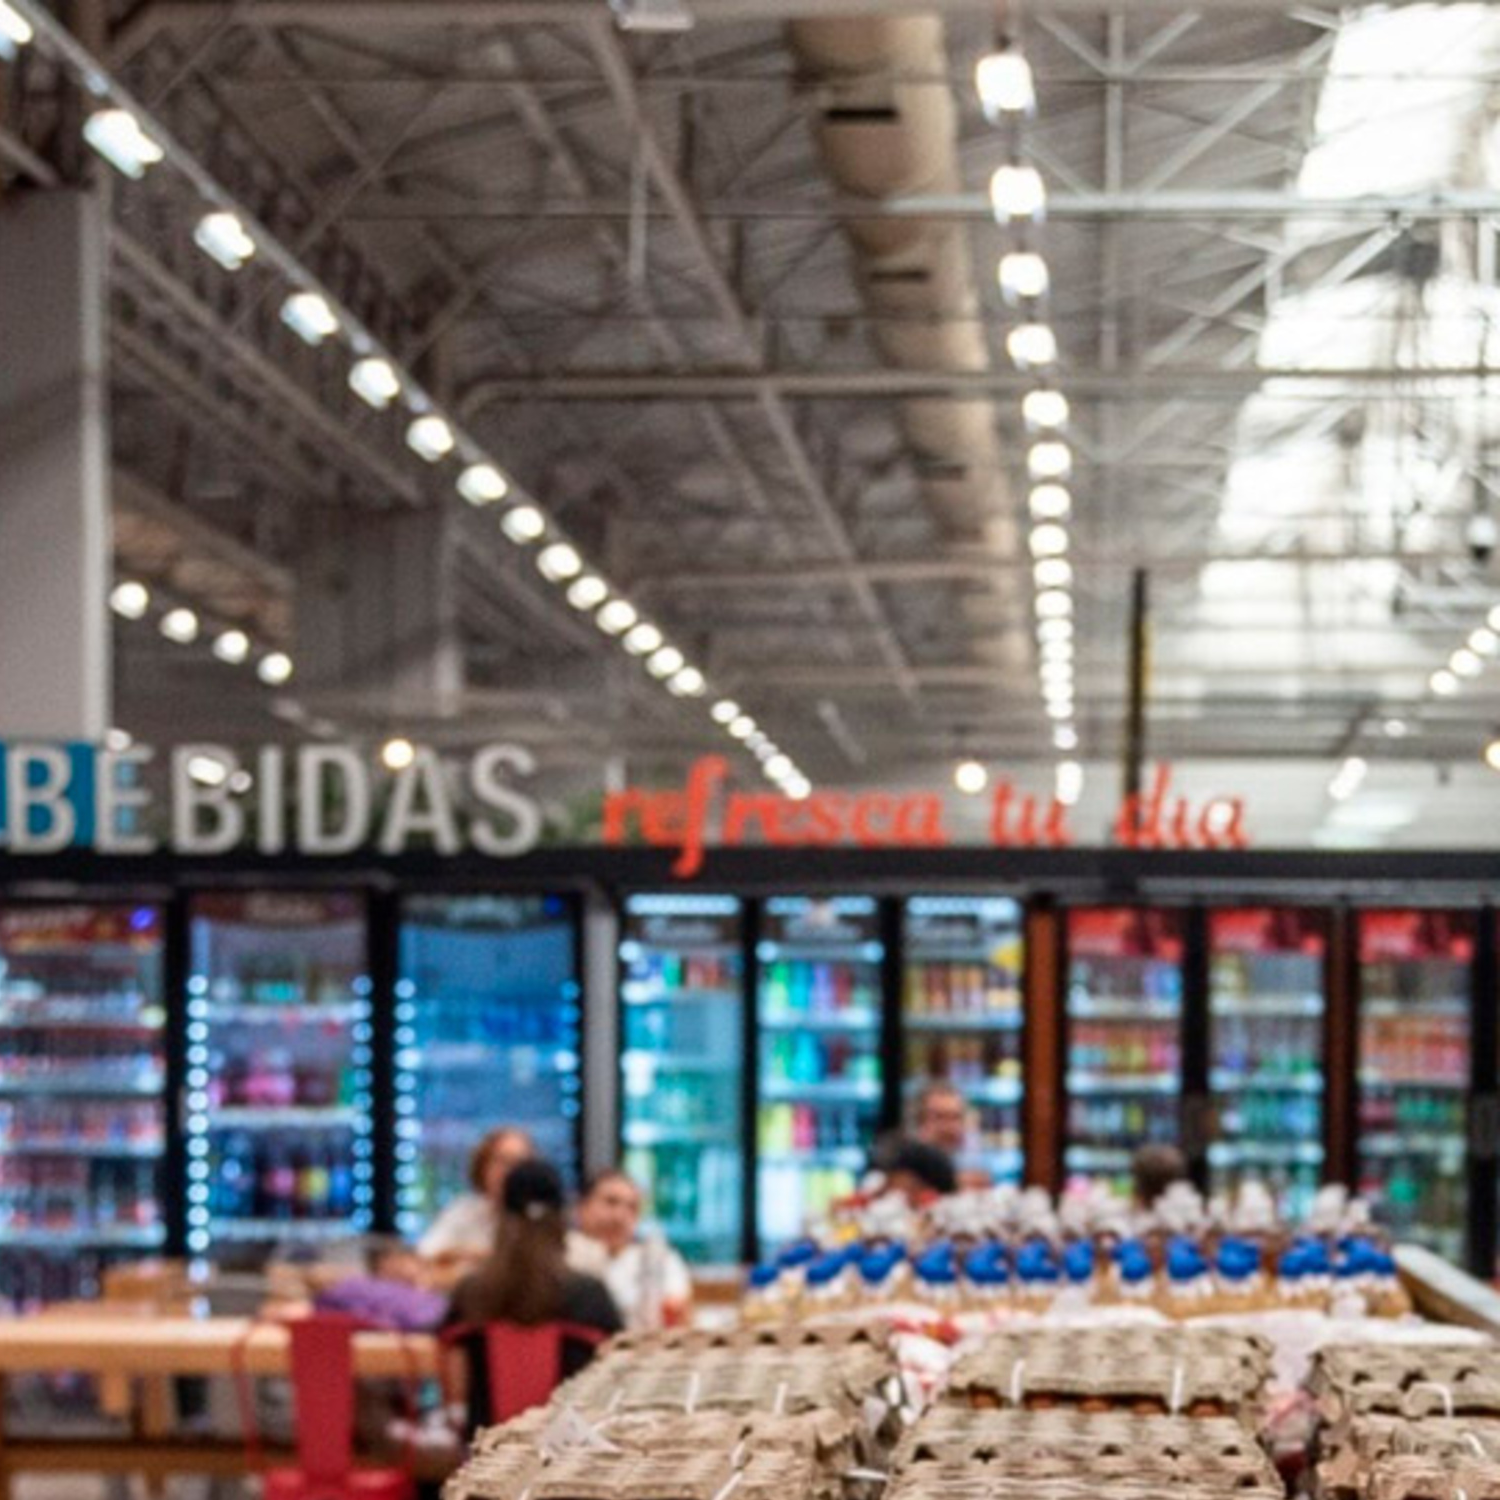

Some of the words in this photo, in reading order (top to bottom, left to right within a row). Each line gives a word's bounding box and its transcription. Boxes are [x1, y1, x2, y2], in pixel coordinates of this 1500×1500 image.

[5, 743, 541, 855] BEBIDAS
[604, 755, 947, 878] refresca
[990, 778, 1072, 847] tu
